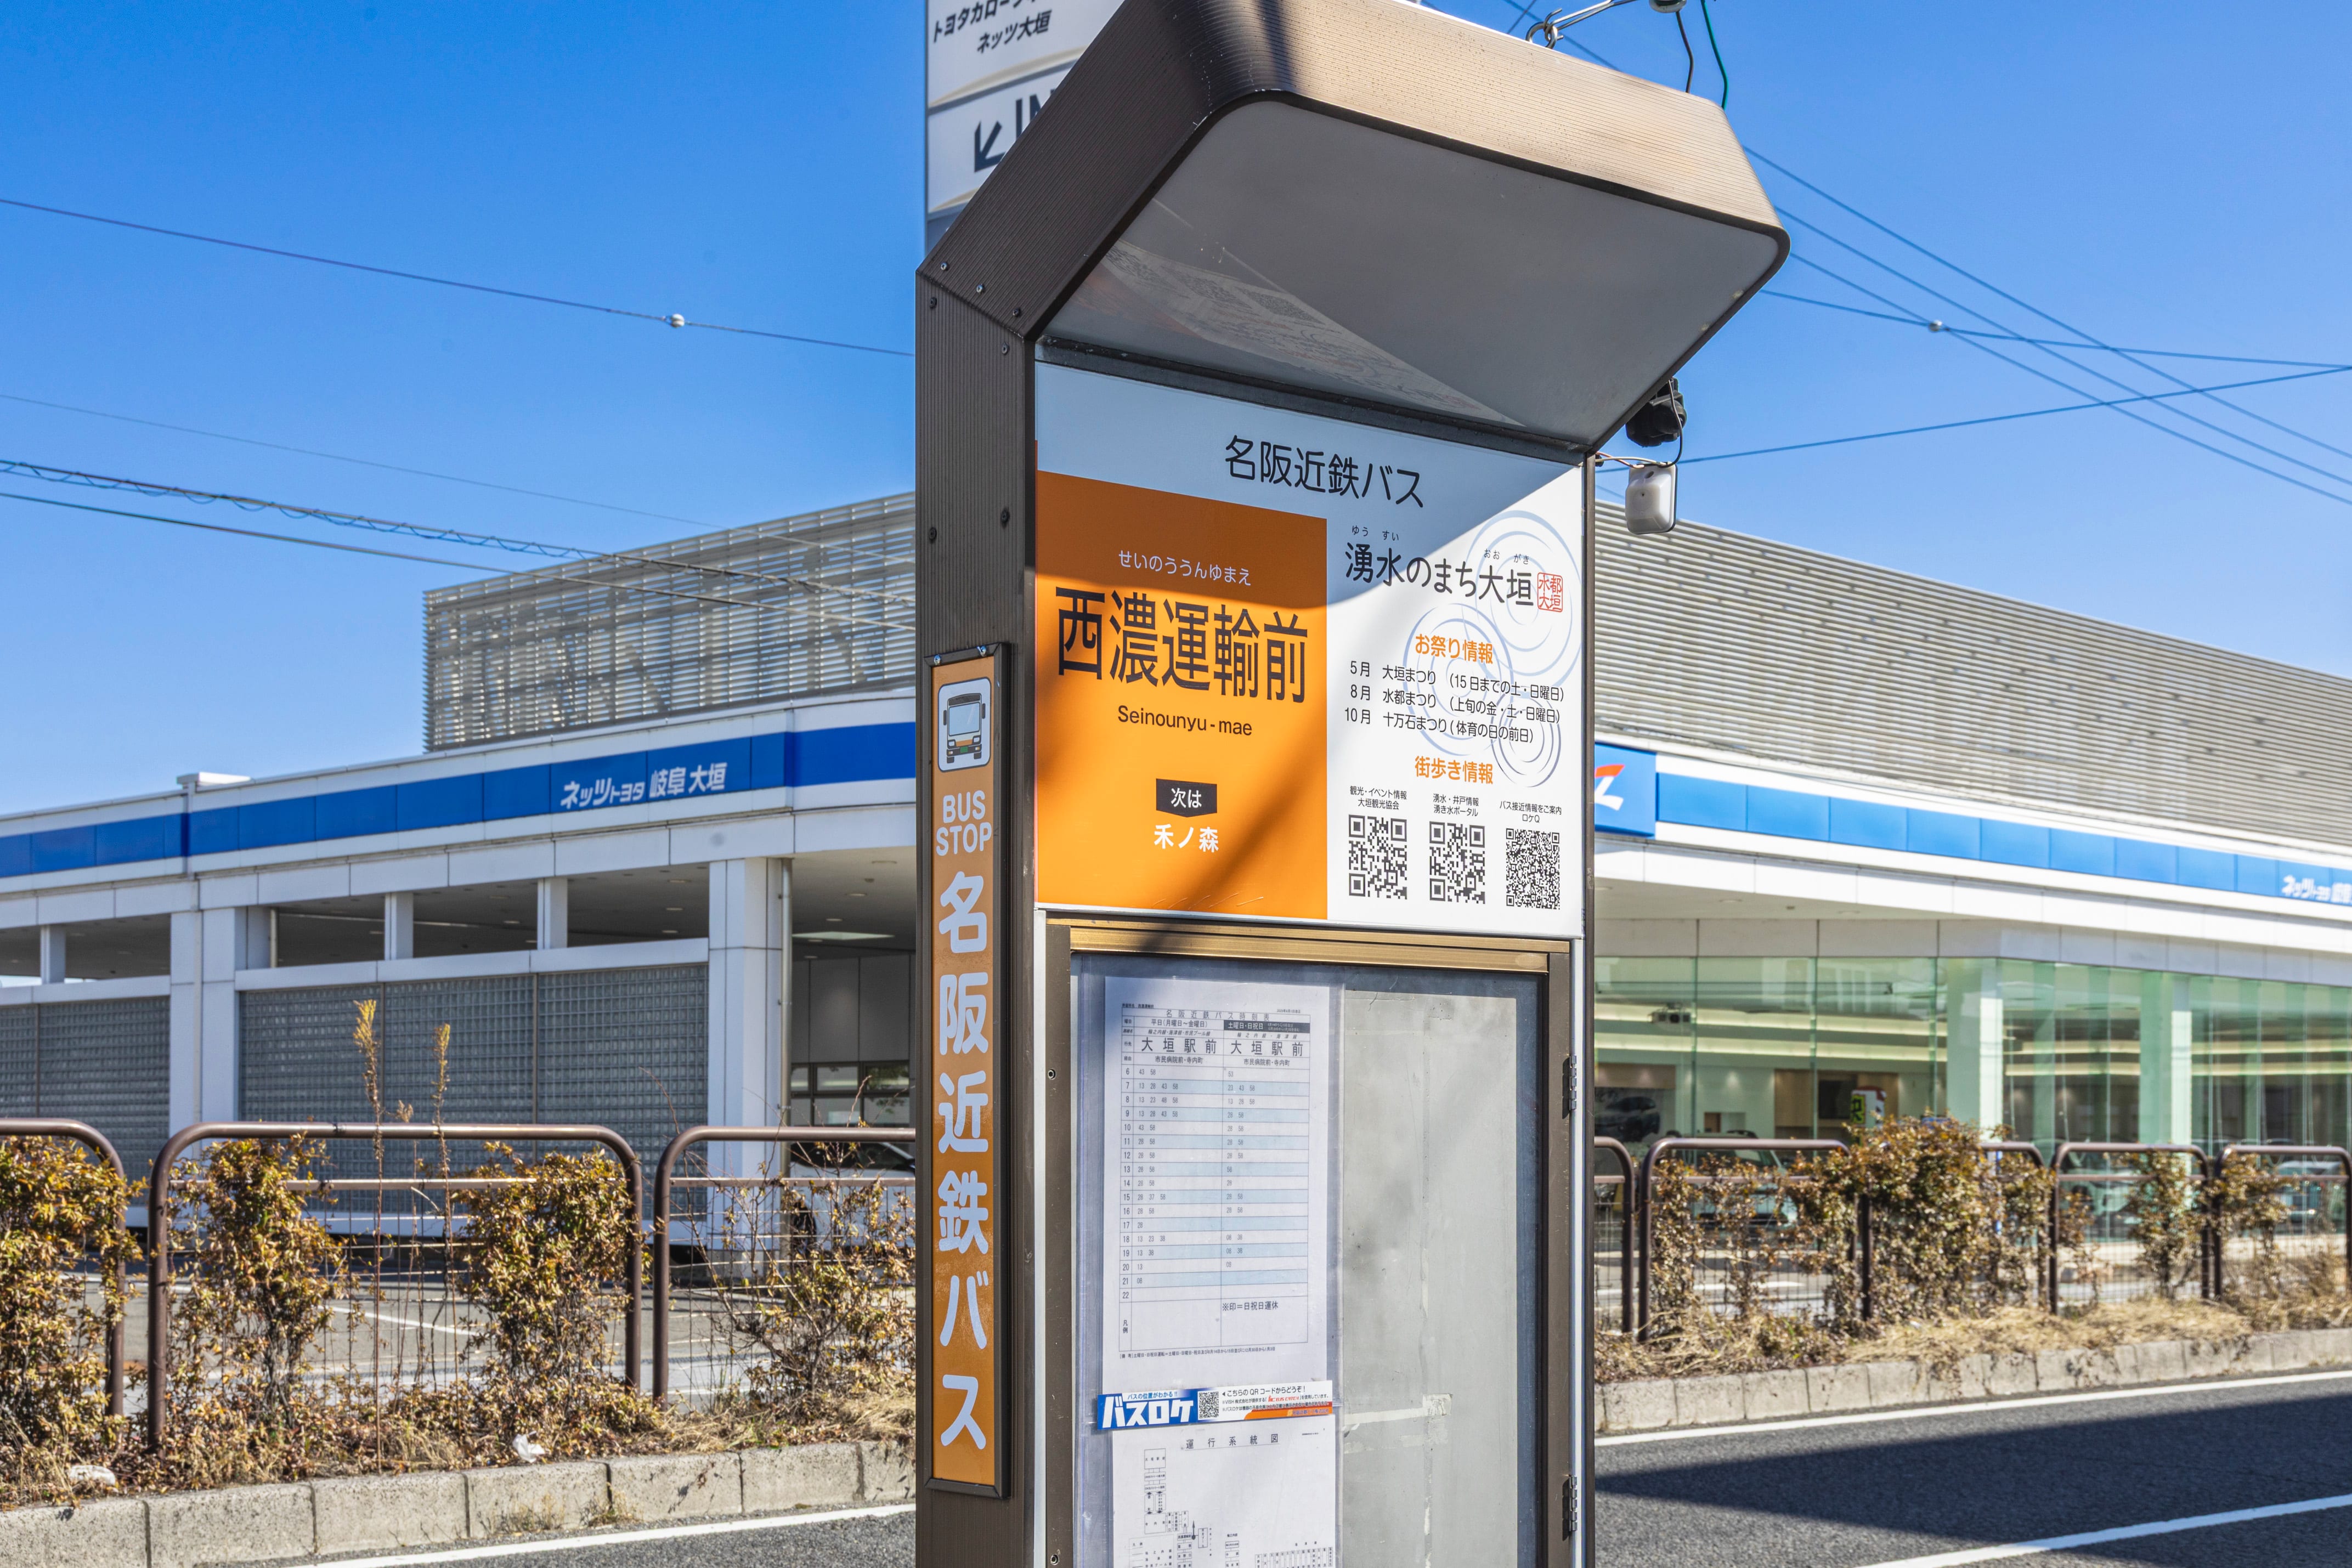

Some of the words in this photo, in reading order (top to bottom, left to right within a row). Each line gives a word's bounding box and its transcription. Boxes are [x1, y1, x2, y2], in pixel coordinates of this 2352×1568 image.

[977, 10, 1052, 54] ネッツ大垣
[1225, 435, 1423, 508] 名阪近鉄バス
[1118, 550, 1251, 586] せいのううんゆまえ
[1345, 542, 1534, 606] 湧水のまち大垣
[1056, 586, 1308, 703] 西濃運輸前
[1415, 634, 1493, 664] お祭り情報
[1382, 665, 1436, 685] 大垣まつり
[1382, 688, 1436, 708] 水都まつり
[1415, 756, 1493, 784] 街歩き情報
[1171, 788, 1202, 808] 次は
[1350, 785, 1407, 800] 観光・イベント情報
[1358, 798, 1399, 810] 大垣観光協会
[1433, 793, 1479, 806] 湧水・井戸情報
[943, 790, 986, 824] BUS
[1434, 804, 1478, 817] 湧き水ポータル
[1500, 801, 1562, 815] バス接近情報をご案内
[936, 823, 992, 856] STOP
[1154, 824, 1219, 853] 禾ノ森
[1141, 1037, 1217, 1054] 大垣駅前
[1231, 1040, 1303, 1056] 大垣駅前
[938, 871, 988, 1450] 名阪近鉄バス
[1102, 1396, 1191, 1429] バスロケ
[1185, 1433, 1279, 1450] 運行系統図
